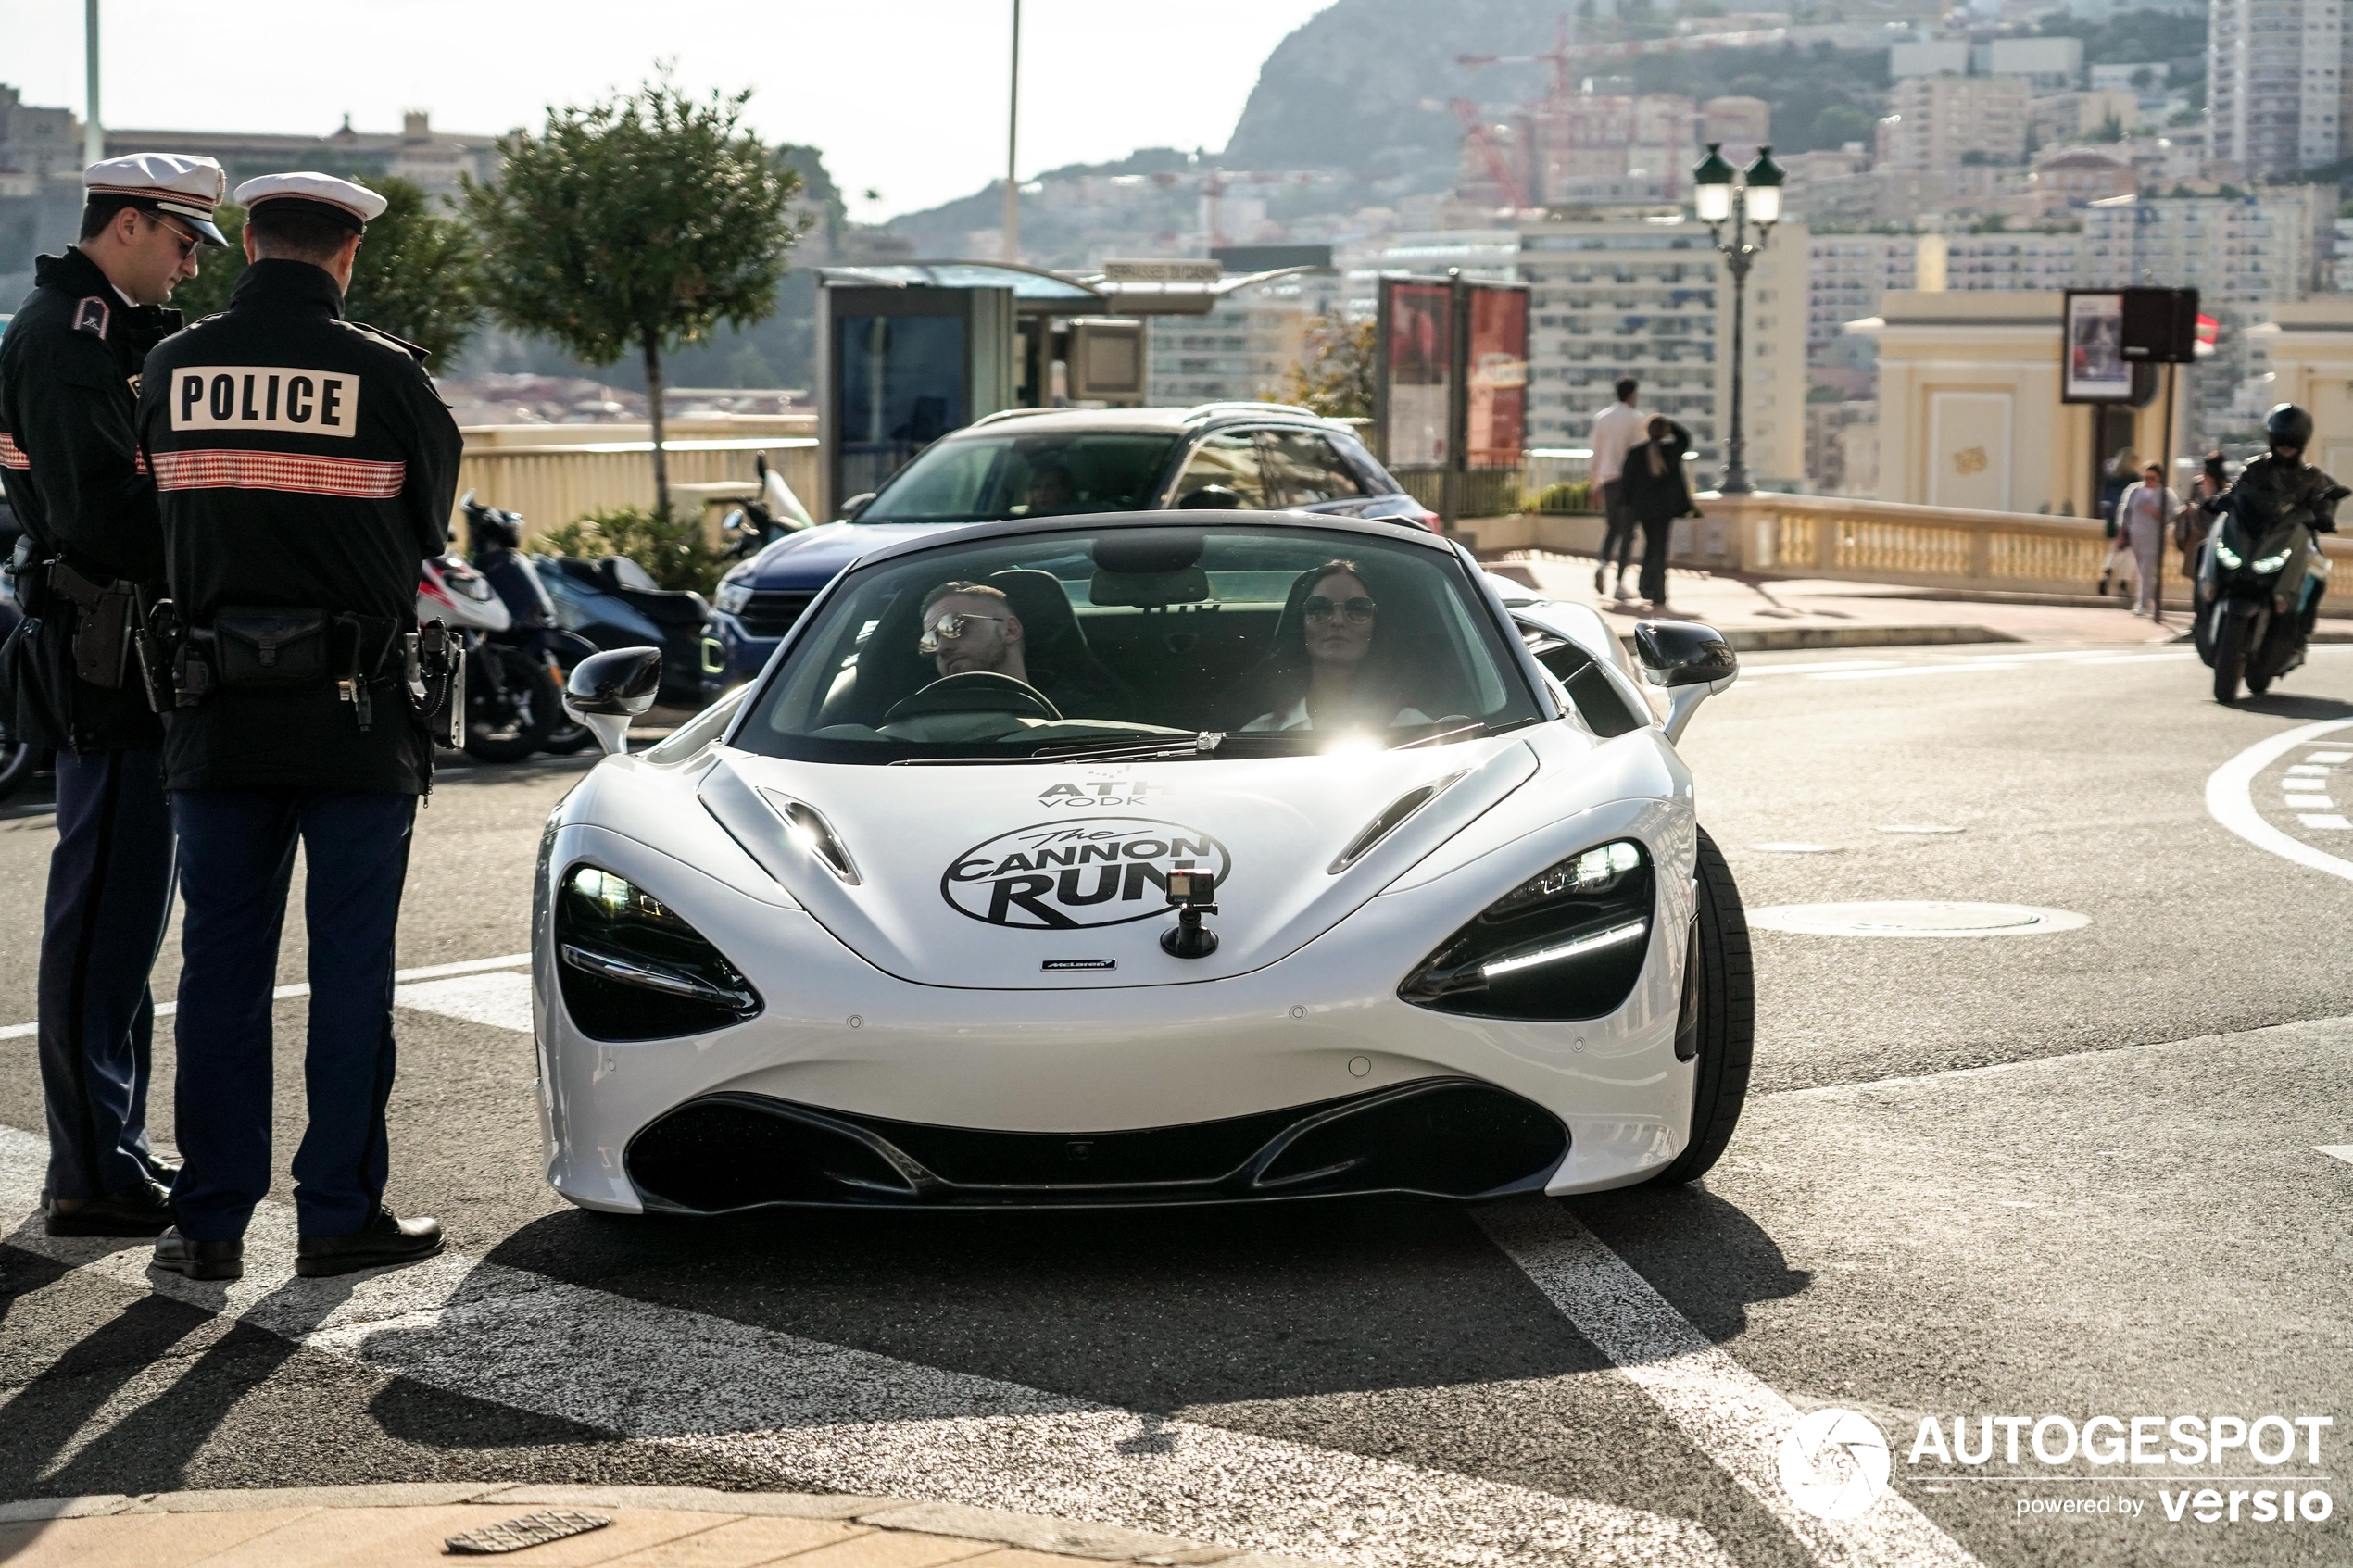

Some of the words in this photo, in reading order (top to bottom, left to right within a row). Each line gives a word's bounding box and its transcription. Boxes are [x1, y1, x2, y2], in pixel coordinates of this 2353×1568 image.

[182, 373, 343, 426] POLICE
[1037, 781, 1177, 798] ATH
[1038, 797, 1149, 808] VODK
[1018, 828, 1153, 849] The
[948, 837, 1211, 881] CANNON
[969, 859, 1195, 928] RUN
